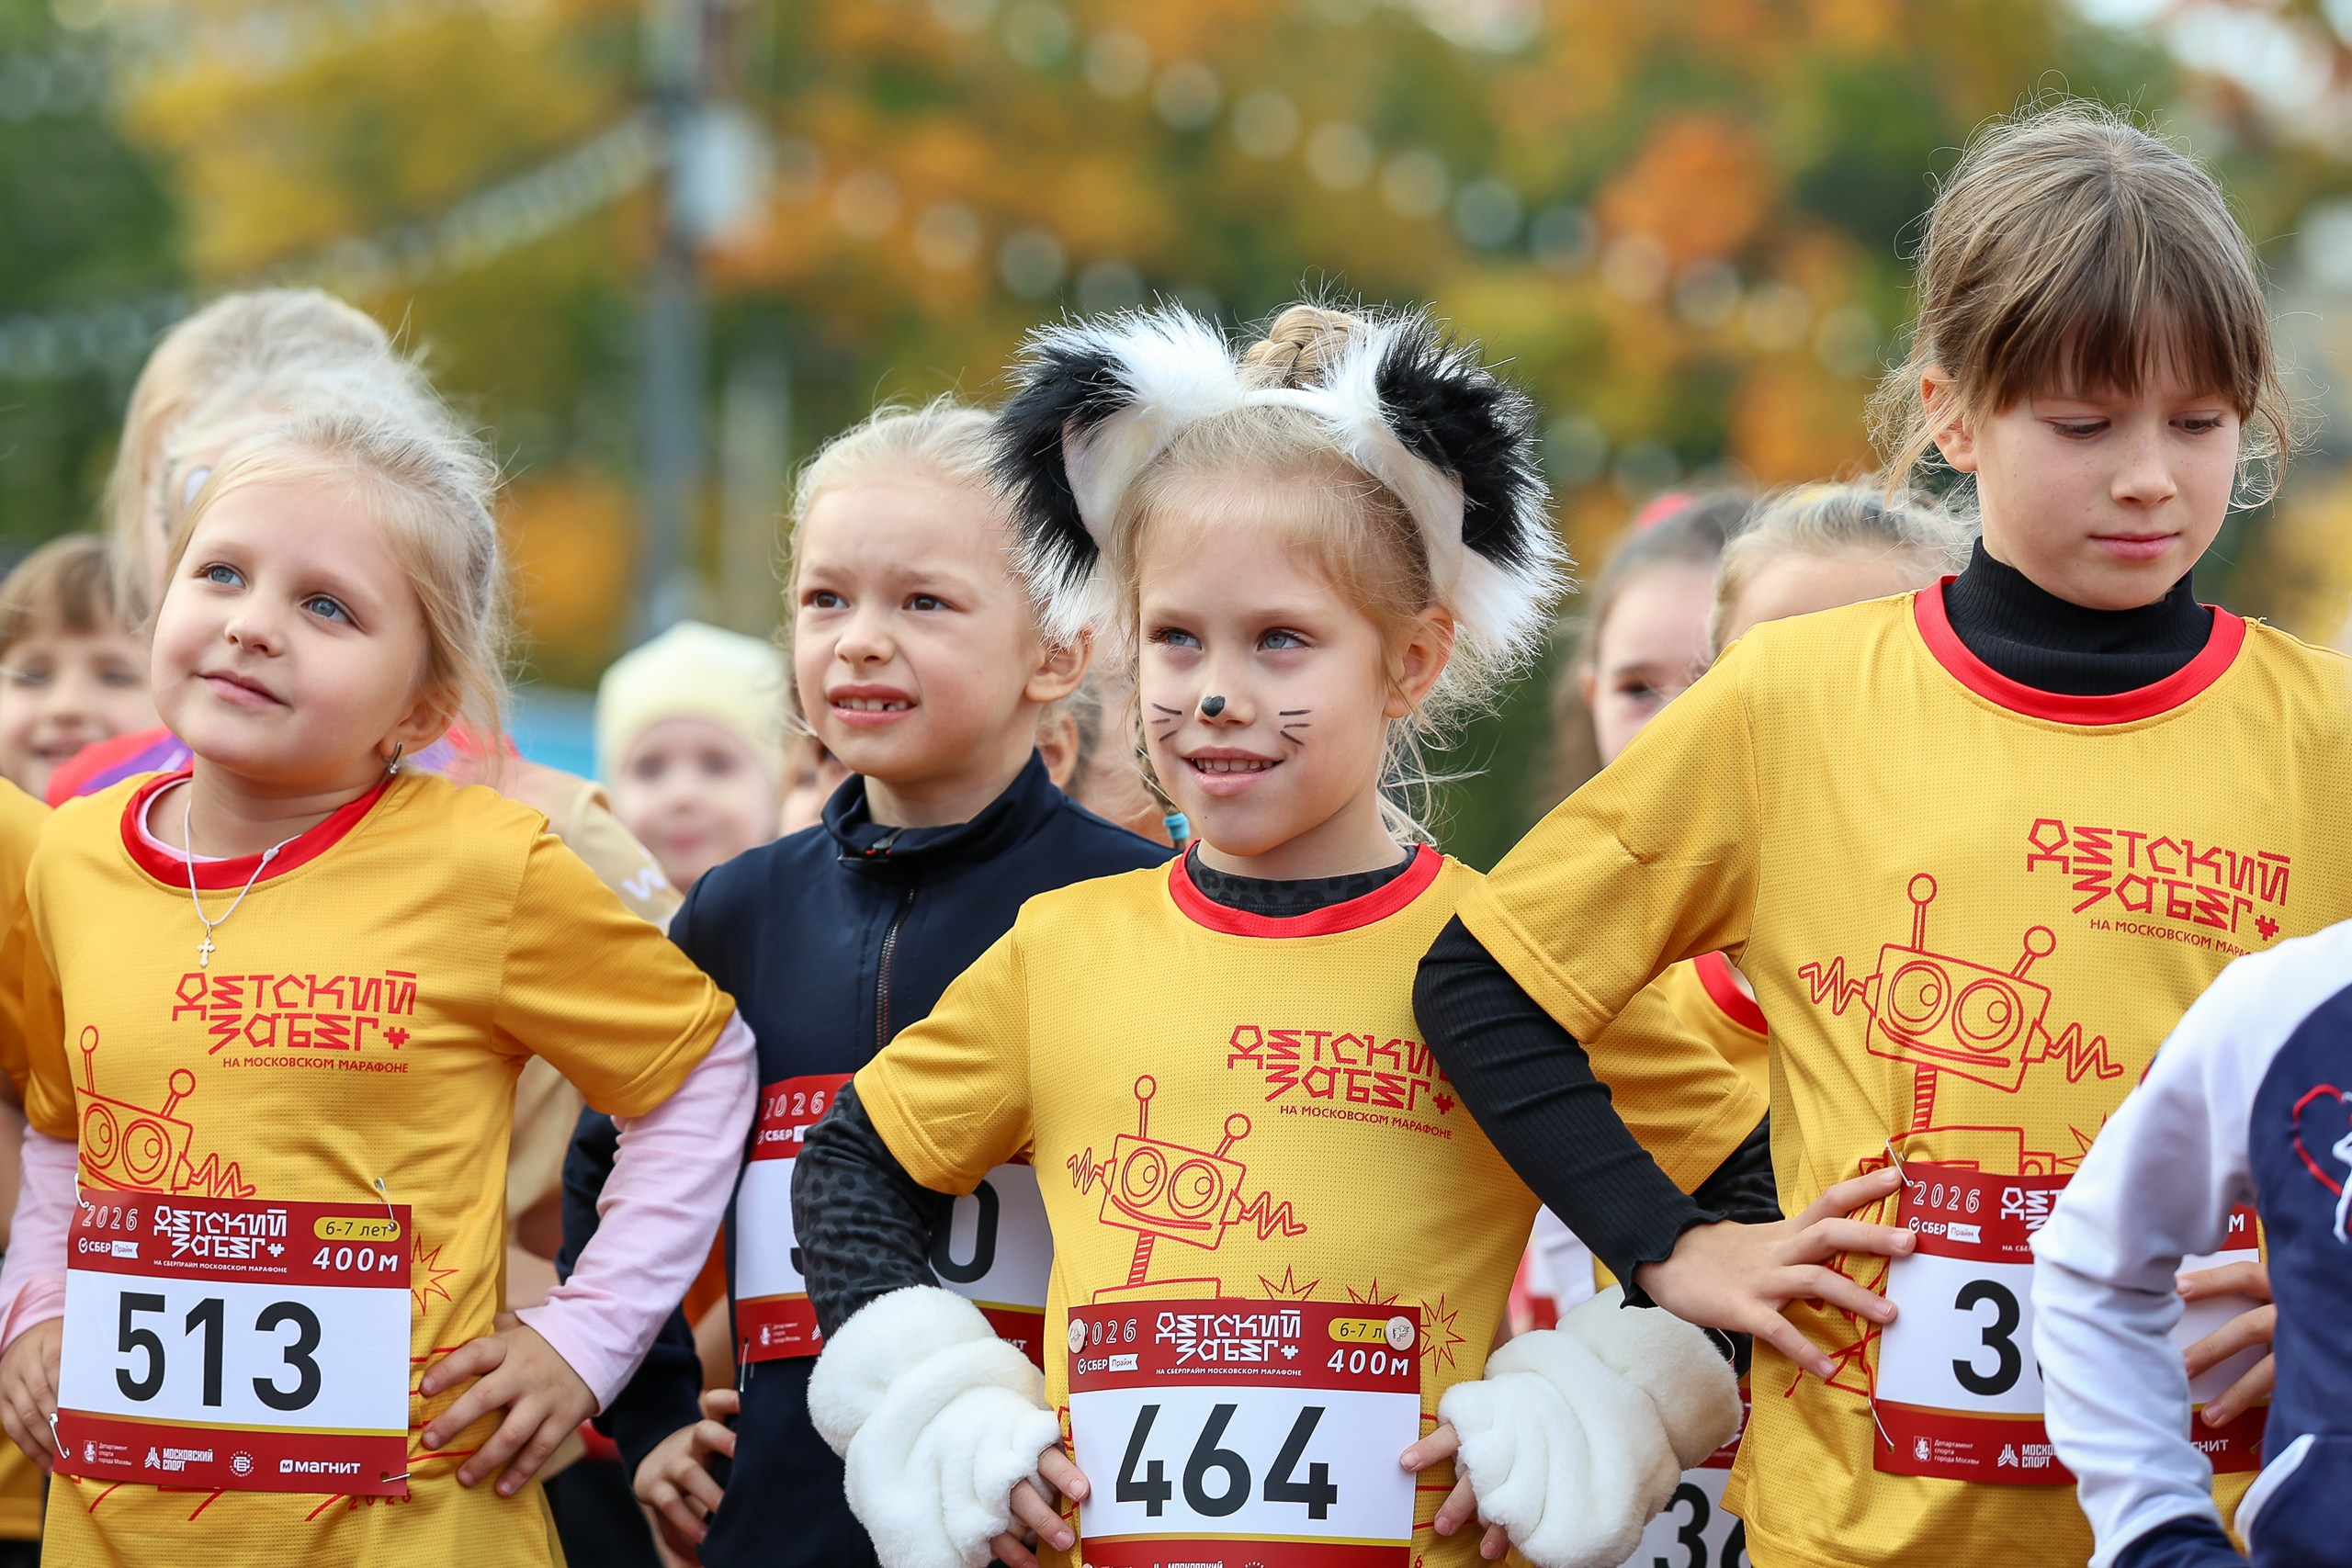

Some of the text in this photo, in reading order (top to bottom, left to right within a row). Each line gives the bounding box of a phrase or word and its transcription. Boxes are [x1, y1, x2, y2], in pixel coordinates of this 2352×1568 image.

[2027, 818, 2290, 907] ДЕТСКИЙ
[2072, 868, 2253, 933] ЗАБЕГ
[2090, 919, 2110, 931] НА
[2115, 920, 2211, 949] МОСКОВСКОМ
[172, 970, 416, 1021] ДЕТСКИЙ
[208, 1012, 379, 1055] ЗАБЕГ
[223, 1057, 409, 1074] НА МОСКОВСКОМ МАРАФОНЕ
[1227, 1025, 1452, 1083] ДЕТСКИ
[1265, 1065, 1430, 1111] ЗАБЕГ
[1280, 1105, 1453, 1140] НА МОСКОВСКОМ МАРАФОНЕ
[1913, 1180, 1981, 1213] 2026
[82, 1204, 138, 1232] 2026
[153, 1205, 287, 1237] ДЕТСКИЙ
[325, 1221, 389, 1236] 6-7 лет
[1921, 1221, 1974, 1238] СБЕР Прайм
[88, 1241, 111, 1254] СБЕР
[171, 1234, 266, 1258] ЗАБЕГ
[163, 1260, 198, 1269] СБЕРПРАЙМ
[199, 1262, 247, 1272] МОСКОВСКОМ
[248, 1265, 288, 1273] МАРАФОНЕ
[1156, 1309, 1301, 1344] ДЕТСКИЙ
[1340, 1322, 1367, 1337] 6-7
[115, 1291, 322, 1412] 513
[1087, 1359, 1133, 1371] СБЕР Прайм
[1175, 1338, 1278, 1365] ЗАБЕГ
[1167, 1367, 1205, 1375] СБЕРПРАЙМ
[1261, 1368, 1302, 1376] МАРАФОНЕ
[163, 1448, 213, 1462] МОСКОВСКИЙ
[163, 1459, 187, 1472] СПОРТ
[1115, 1403, 1338, 1520] 464
[2022, 1458, 2050, 1469] СПОРТ
